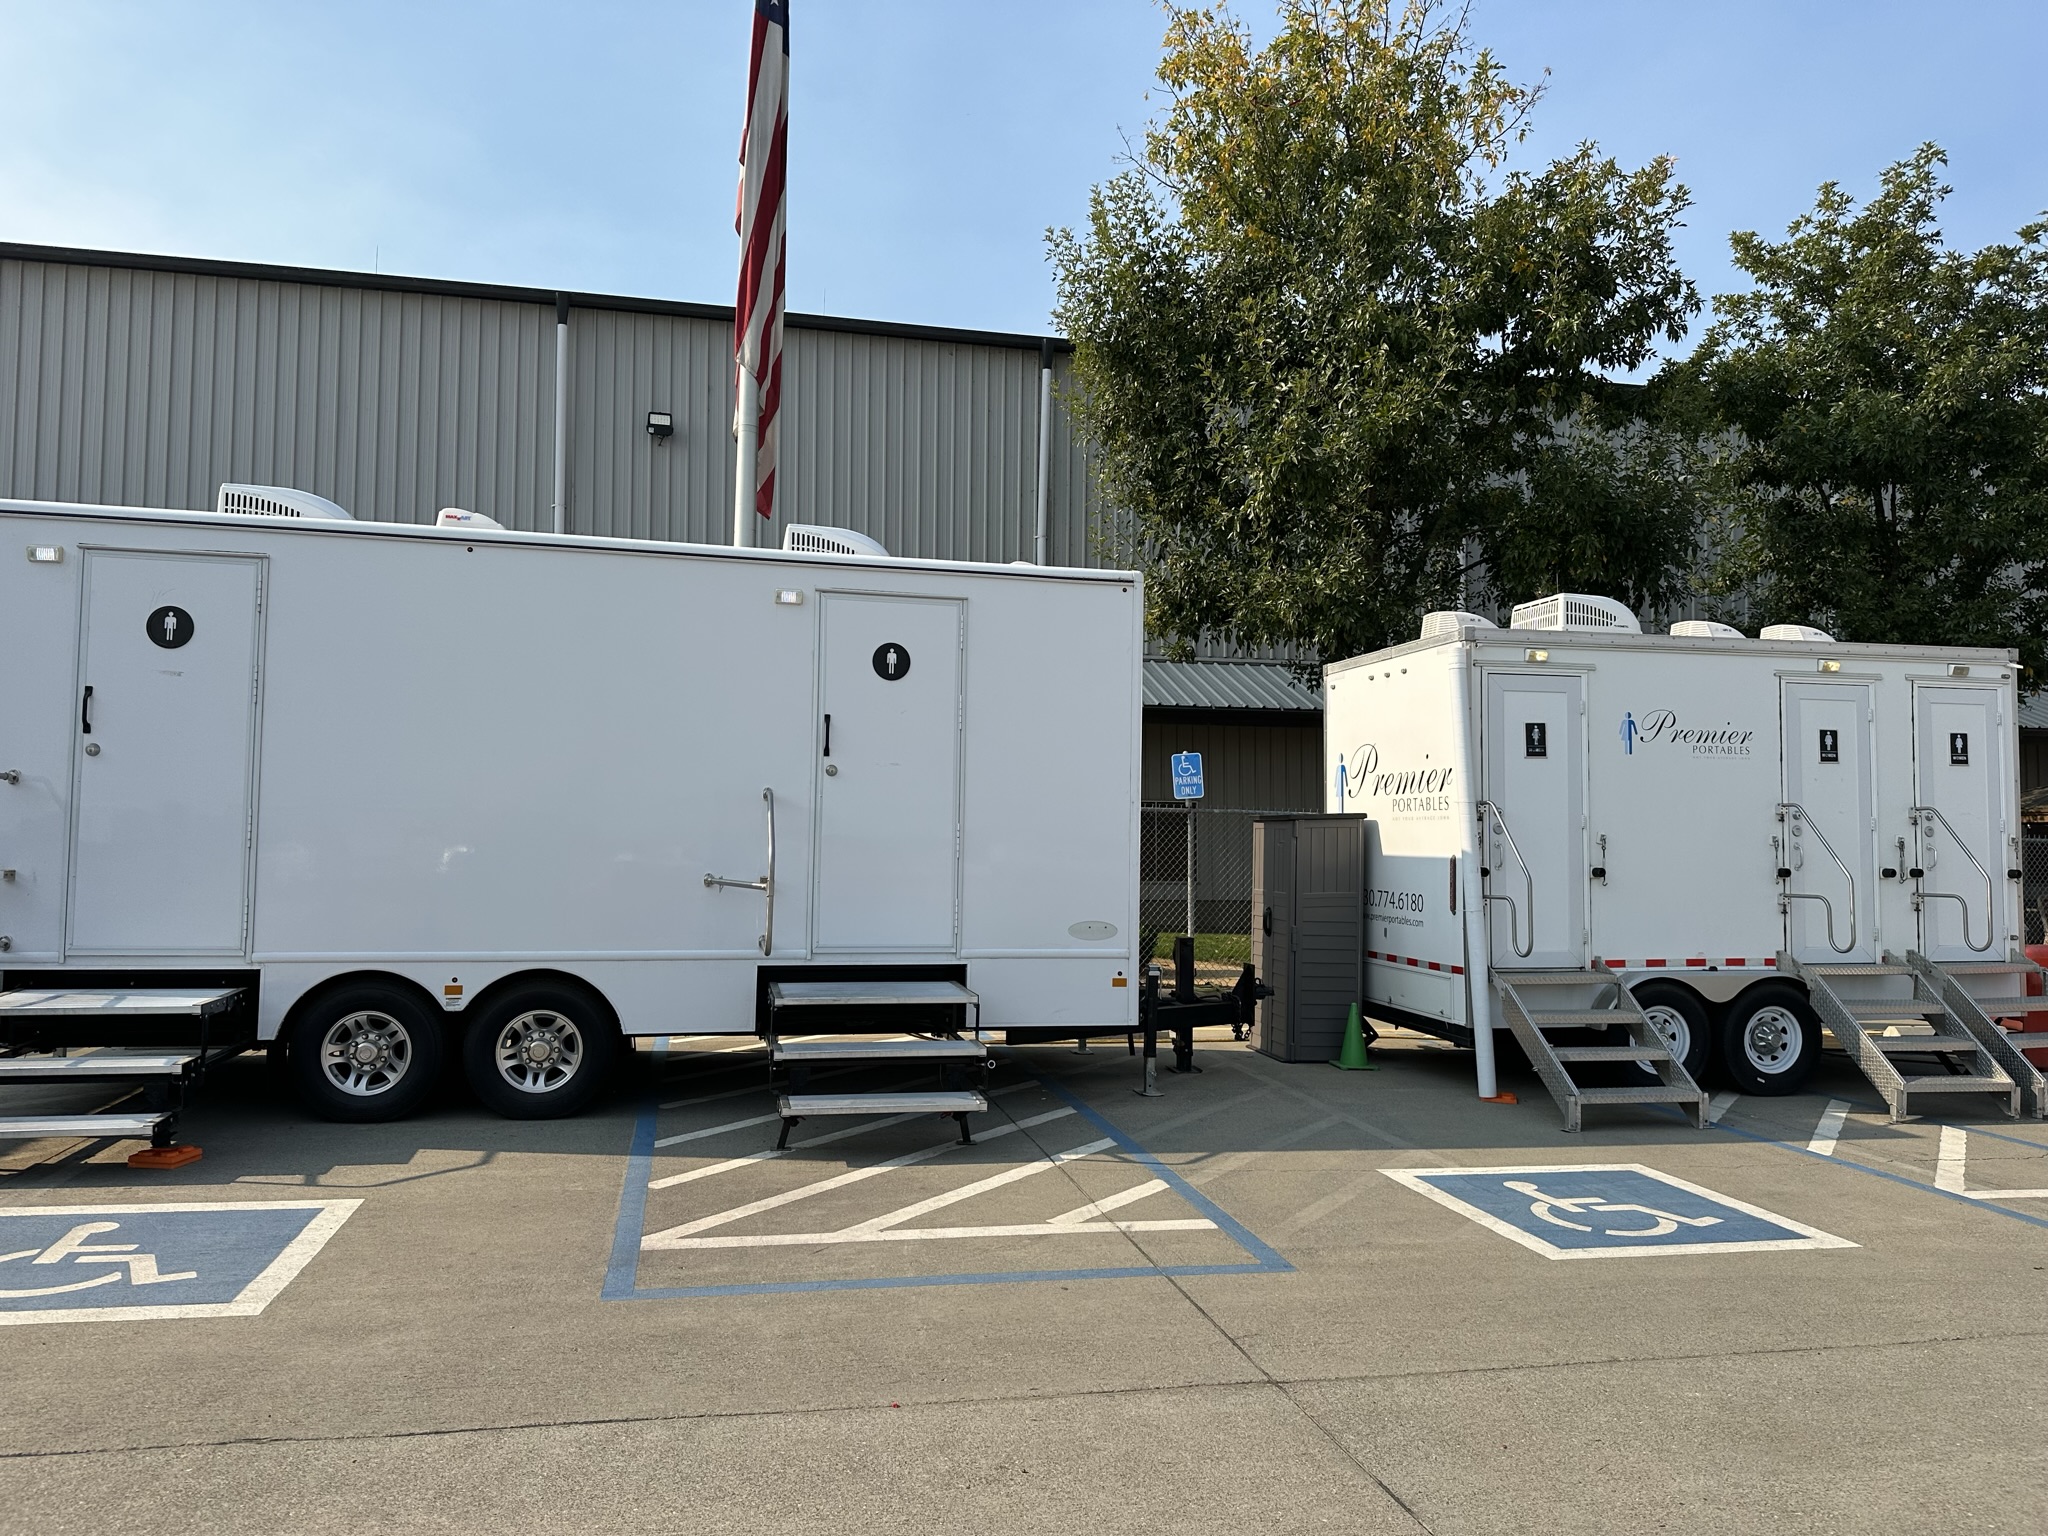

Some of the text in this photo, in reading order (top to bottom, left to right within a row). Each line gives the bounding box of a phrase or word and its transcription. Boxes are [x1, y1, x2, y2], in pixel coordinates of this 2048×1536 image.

[1640, 708, 1753, 745] Premier
[1692, 745, 1751, 755] PORTABLES
[1348, 742, 1454, 799] Premier
[1175, 775, 1202, 785] PARKING
[1181, 786, 1197, 795] ONLY
[1392, 796, 1450, 813] PORTABLES
[1363, 888, 1424, 912] 30.774.6180
